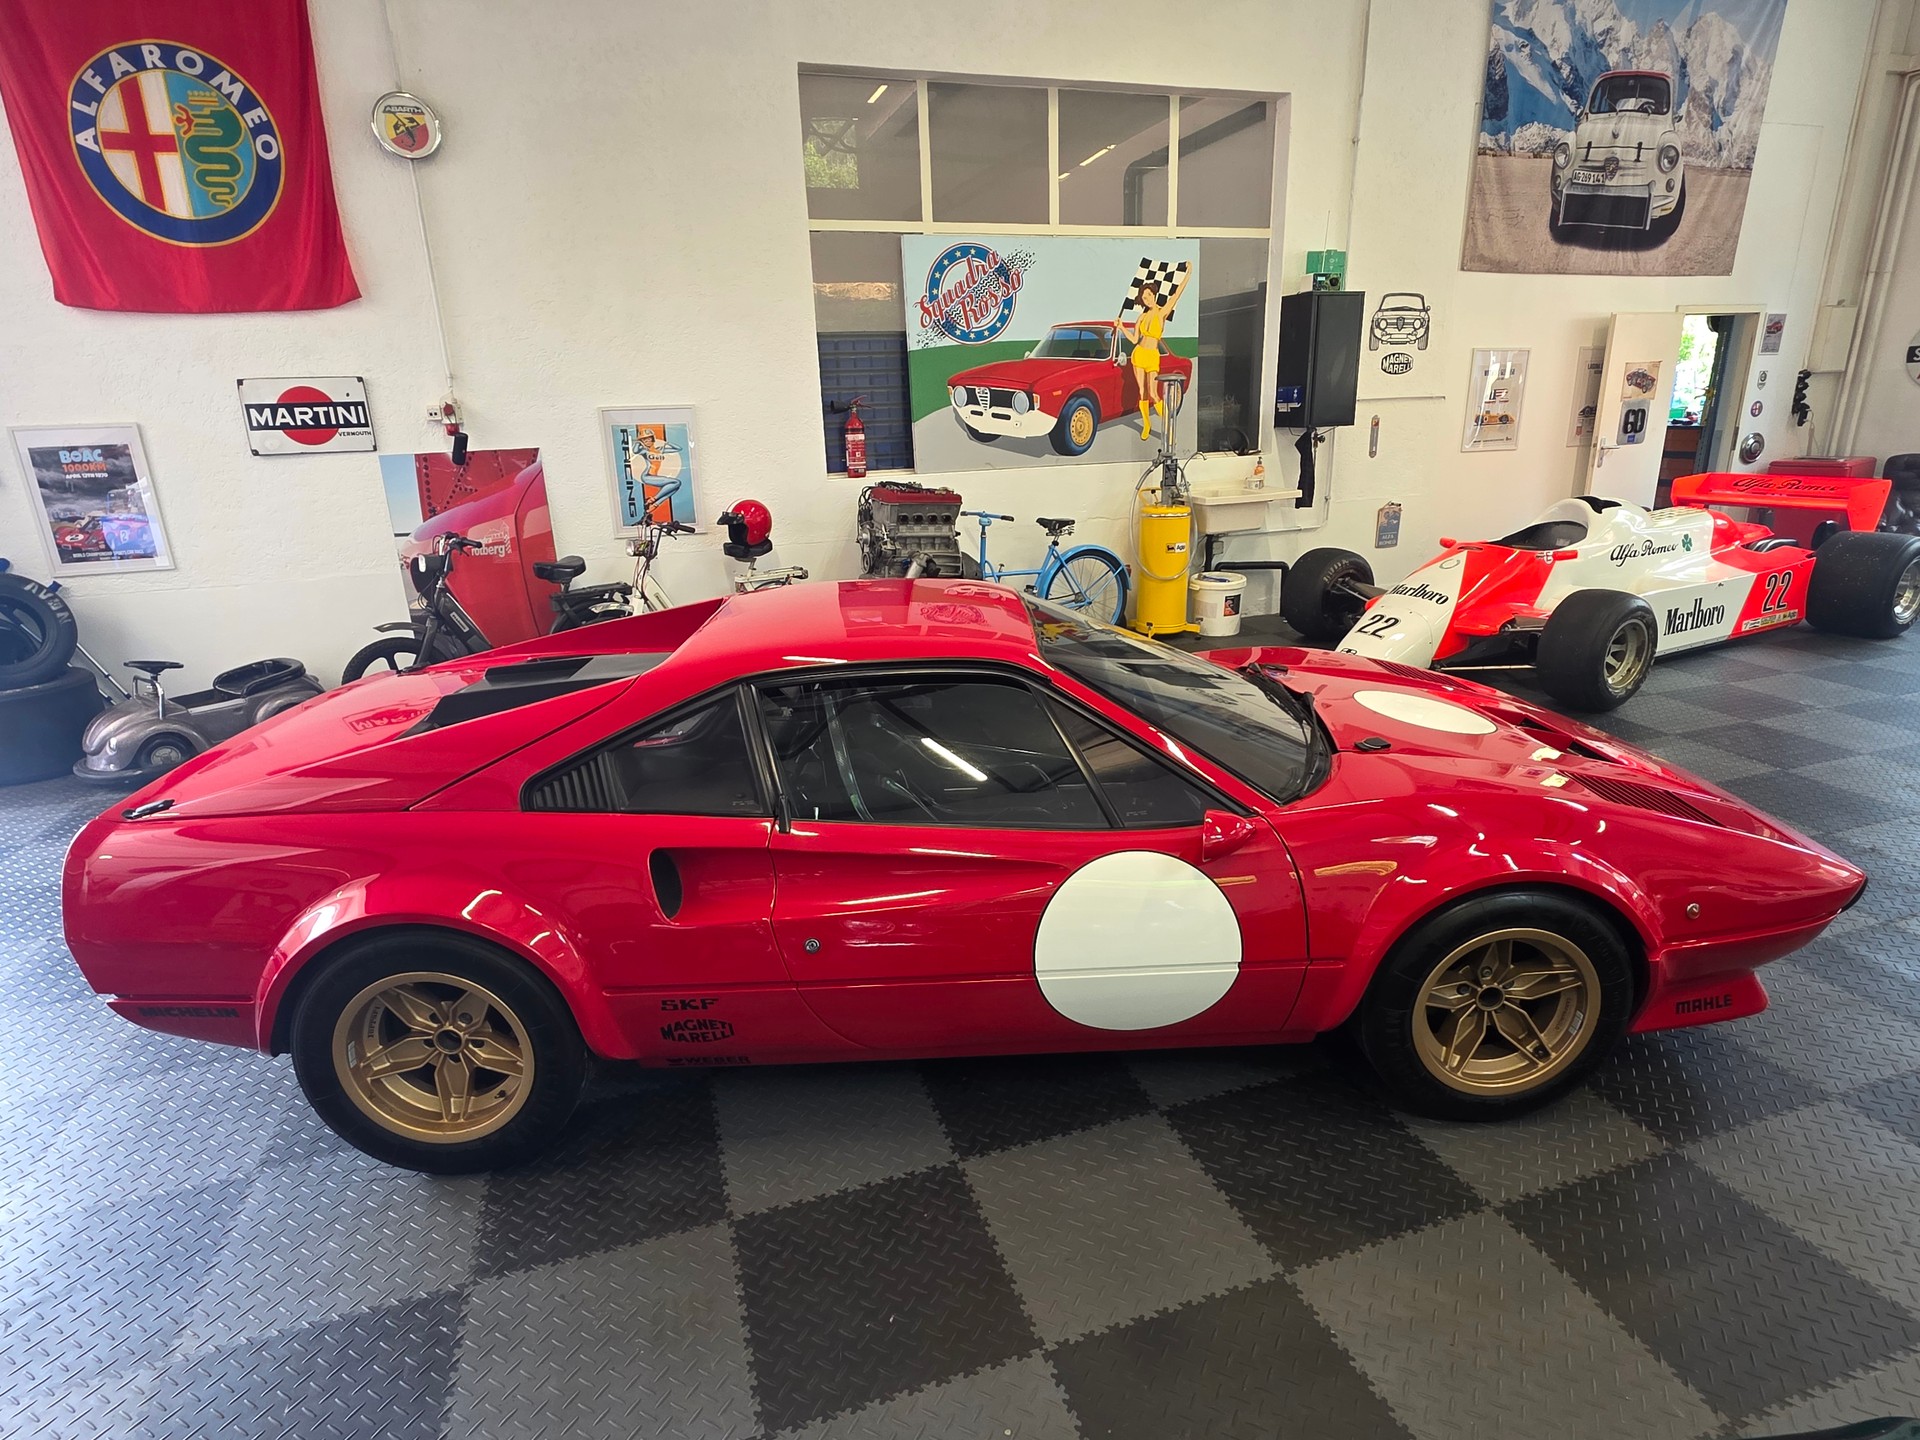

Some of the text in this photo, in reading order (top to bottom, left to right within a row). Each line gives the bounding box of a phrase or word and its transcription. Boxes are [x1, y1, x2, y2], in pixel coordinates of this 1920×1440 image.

[913, 251, 999, 328] Squadra
[960, 268, 1022, 331] Rosso
[249, 406, 366, 427] MARTINI
[1622, 408, 1646, 434] 60
[59, 449, 103, 463] BOAC
[62, 462, 107, 472] 1000KM
[620, 428, 637, 518] RACING
[1732, 477, 1843, 492] Alfa Romeo
[1610, 539, 1679, 567] Alfa Romeo
[1389, 583, 1449, 605] Marlboro
[1762, 570, 1793, 613] 22
[1355, 614, 1399, 638] 22
[1663, 597, 1725, 636] Marlboro
[138, 1006, 240, 1018] MICHELIN
[661, 998, 719, 1011] SKF
[1675, 994, 1733, 1015] MAHLE
[686, 1055, 752, 1065] WEBER
